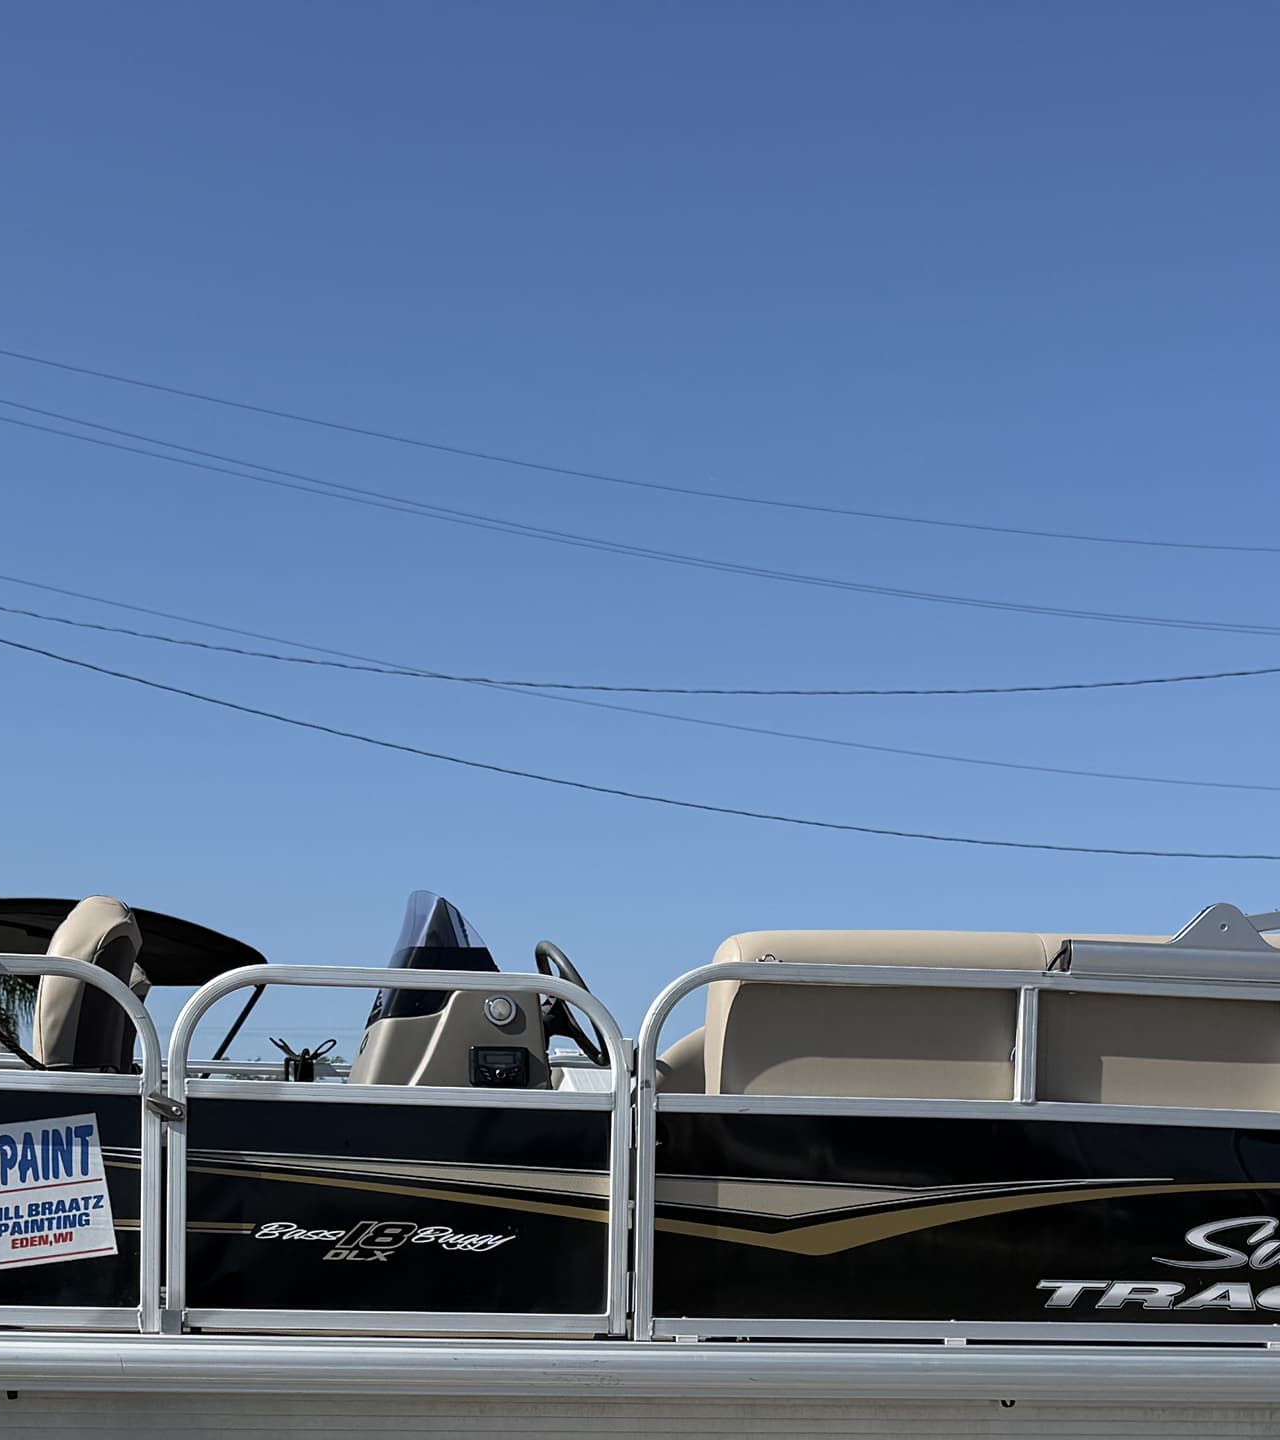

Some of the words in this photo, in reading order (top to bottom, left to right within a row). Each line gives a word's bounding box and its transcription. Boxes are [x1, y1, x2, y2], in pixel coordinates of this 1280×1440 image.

[27, 1194, 104, 1218] BRAATZ
[11, 1231, 73, 1250] EDEN,WI
[255, 1222, 346, 1240] Bass
[335, 1221, 418, 1249] 18
[411, 1226, 516, 1252] Buggy
[322, 1249, 396, 1261] DLX
